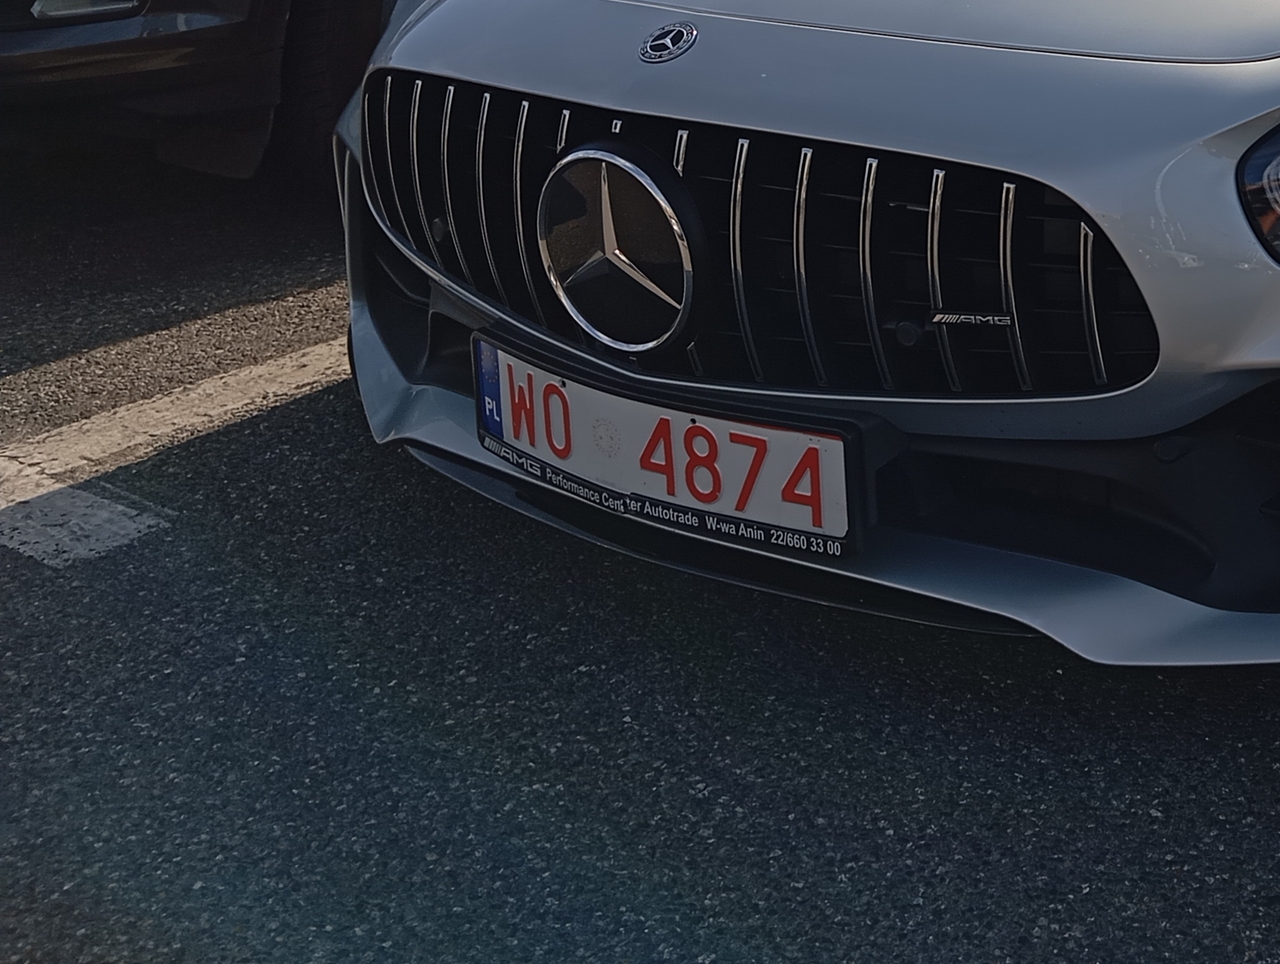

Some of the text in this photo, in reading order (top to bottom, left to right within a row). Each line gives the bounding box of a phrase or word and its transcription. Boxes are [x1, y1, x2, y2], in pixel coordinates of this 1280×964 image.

[484, 396, 500, 422] PL
[546, 467, 600, 503] Performance
[643, 501, 699, 527] Autotrade
[705, 516, 736, 535] W-wa
[738, 523, 764, 541] Anin
[770, 529, 807, 550] 22/660
[810, 537, 824, 553] 33
[827, 540, 841, 556] 00
[639, 416, 823, 529] 4874
